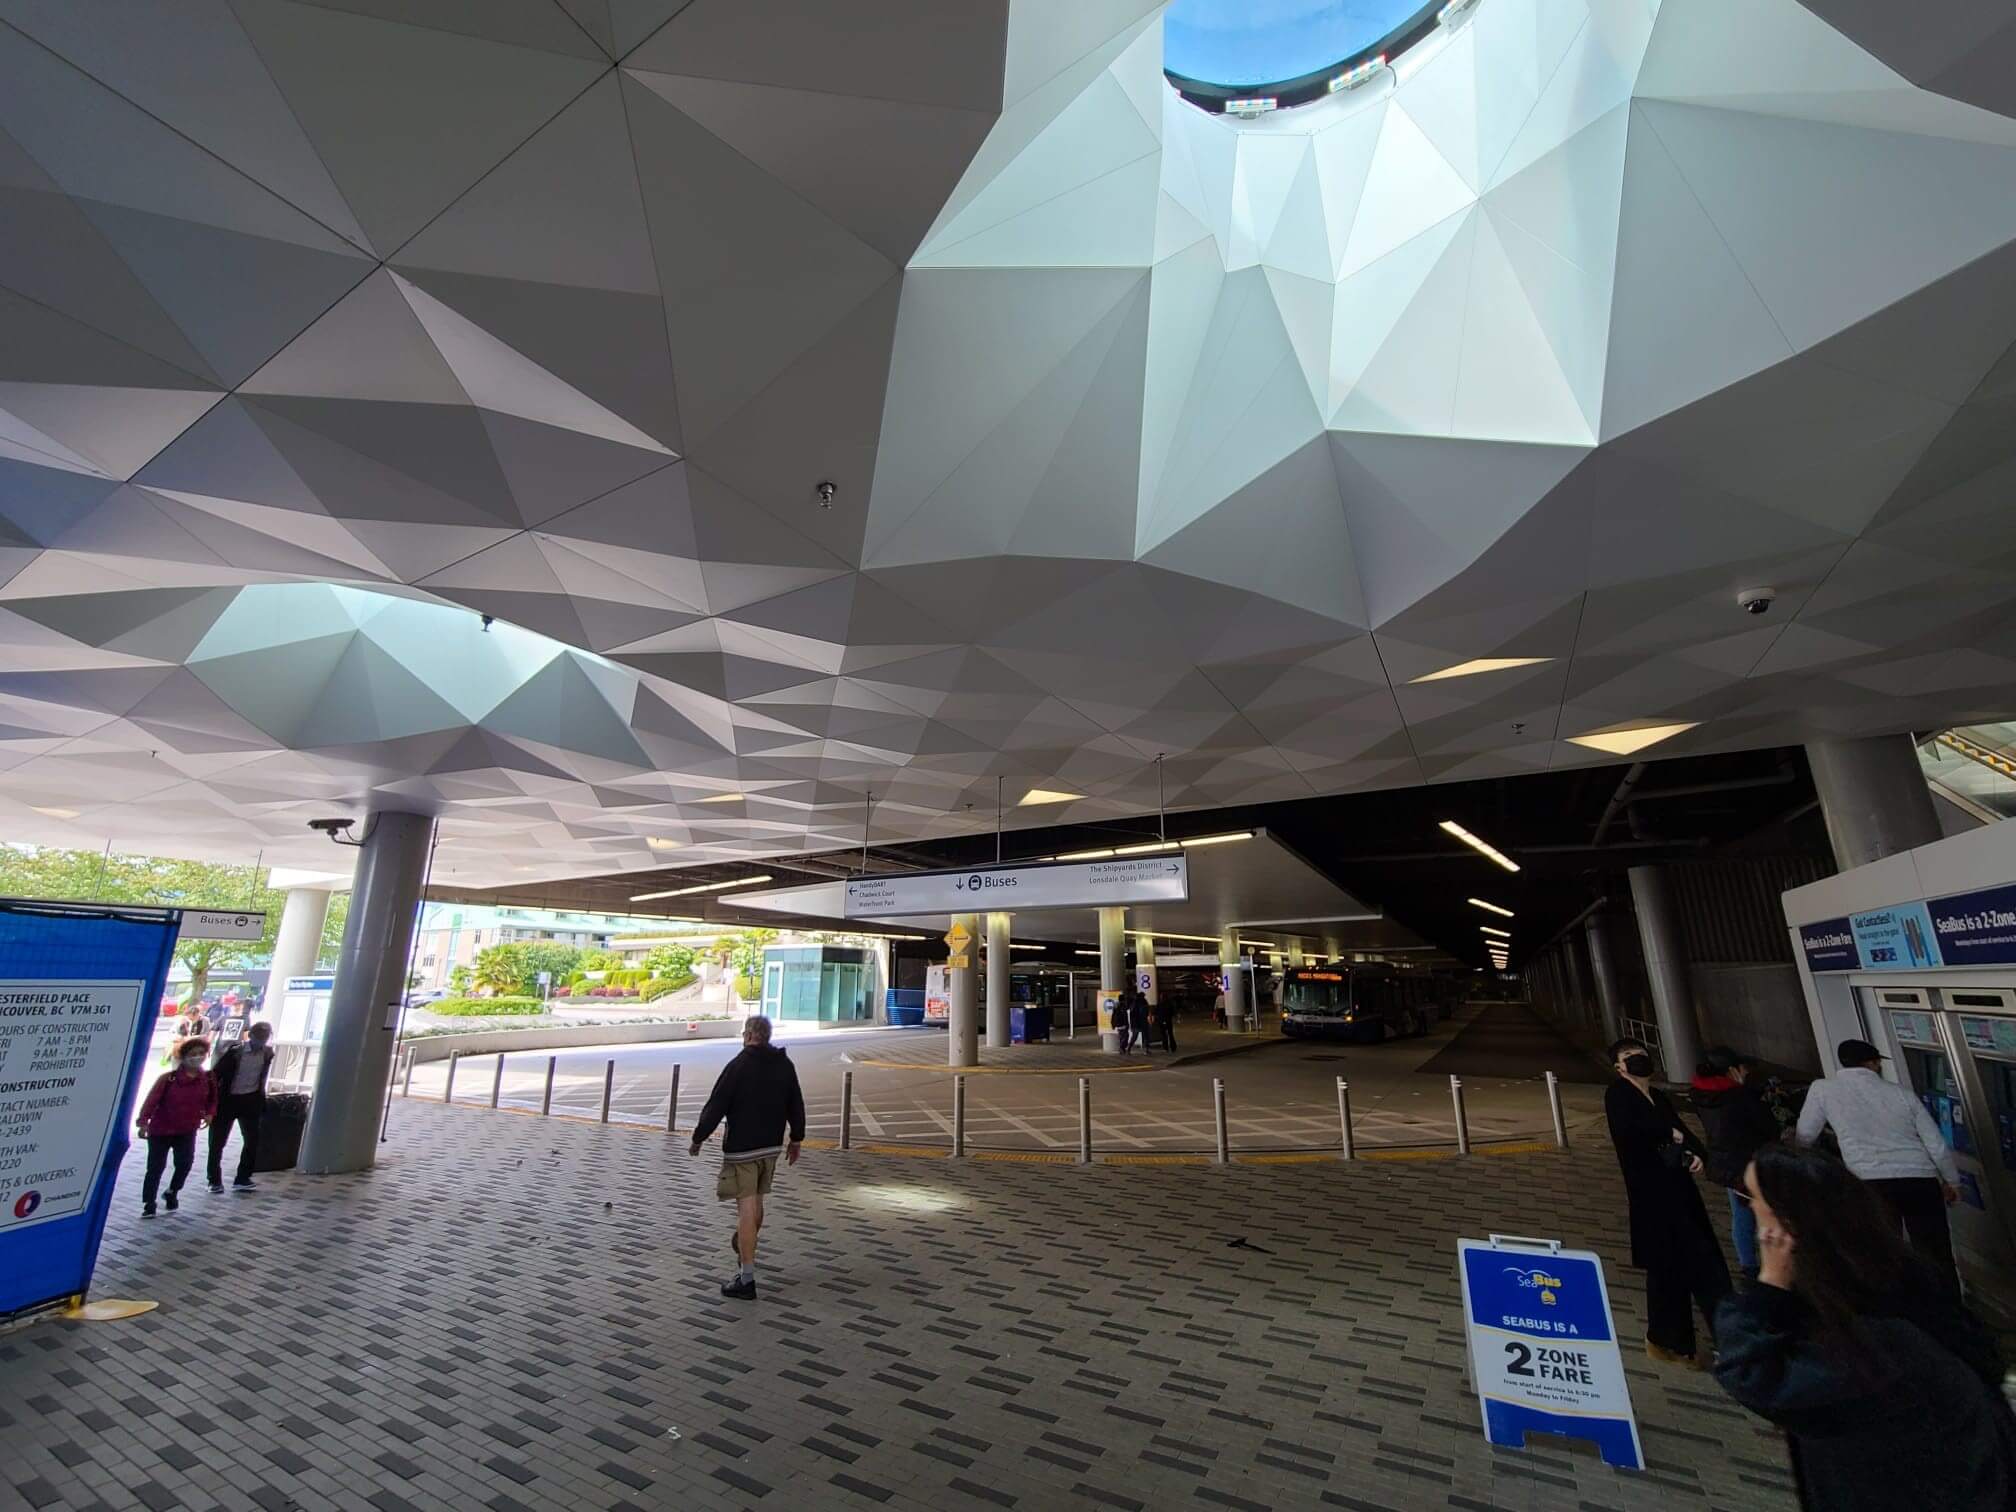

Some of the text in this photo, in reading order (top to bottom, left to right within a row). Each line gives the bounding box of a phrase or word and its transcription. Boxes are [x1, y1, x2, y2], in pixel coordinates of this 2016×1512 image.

[1103, 864, 1136, 873] Shipyards
[1138, 862, 1162, 871] District
[984, 876, 1018, 887] Buses
[1089, 876, 1118, 884] Lonsdale
[1120, 875, 1137, 883] Quay
[200, 914, 233, 925] Buses
[1936, 910, 2016, 934] SeaBus is a 2-Zone
[1140, 974, 1151, 990] 8
[1223, 975, 1231, 991] 1
[0, 993, 91, 1005] ESTERFIELD PLACE
[51, 1005, 65, 1015] BC
[71, 1005, 91, 1015] V7M
[92, 1004, 111, 1015] 3G1
[28, 1024, 41, 1035] OF
[42, 1022, 110, 1034] CONSTRUCTION
[37, 1036, 44, 1046] 7
[44, 1036, 61, 1046] AM
[69, 1035, 76, 1045] 8
[76, 1034, 92, 1044] PM
[33, 1049, 41, 1059] 9
[41, 1048, 58, 1058] AM
[65, 1047, 73, 1057] 7
[74, 1046, 89, 1056] PM
[29, 1058, 86, 1072] PROHIBITED
[26, 1095, 70, 1110] NUMBER:
[16, 1143, 39, 1156] VAN:
[13, 1177, 21, 1188] &
[24, 1167, 78, 1185] CONCERNS:
[1517, 1273, 1562, 1288] SeaBus
[1502, 1315, 1579, 1335] SEABUS IS A
[1504, 1341, 1590, 1377] 2 ZONE
[1539, 1364, 1594, 1385] FARE
[1519, 1381, 1534, 1389] start
[1526, 1390, 1551, 1400] Monday
[1560, 1395, 1580, 1404] Friday
